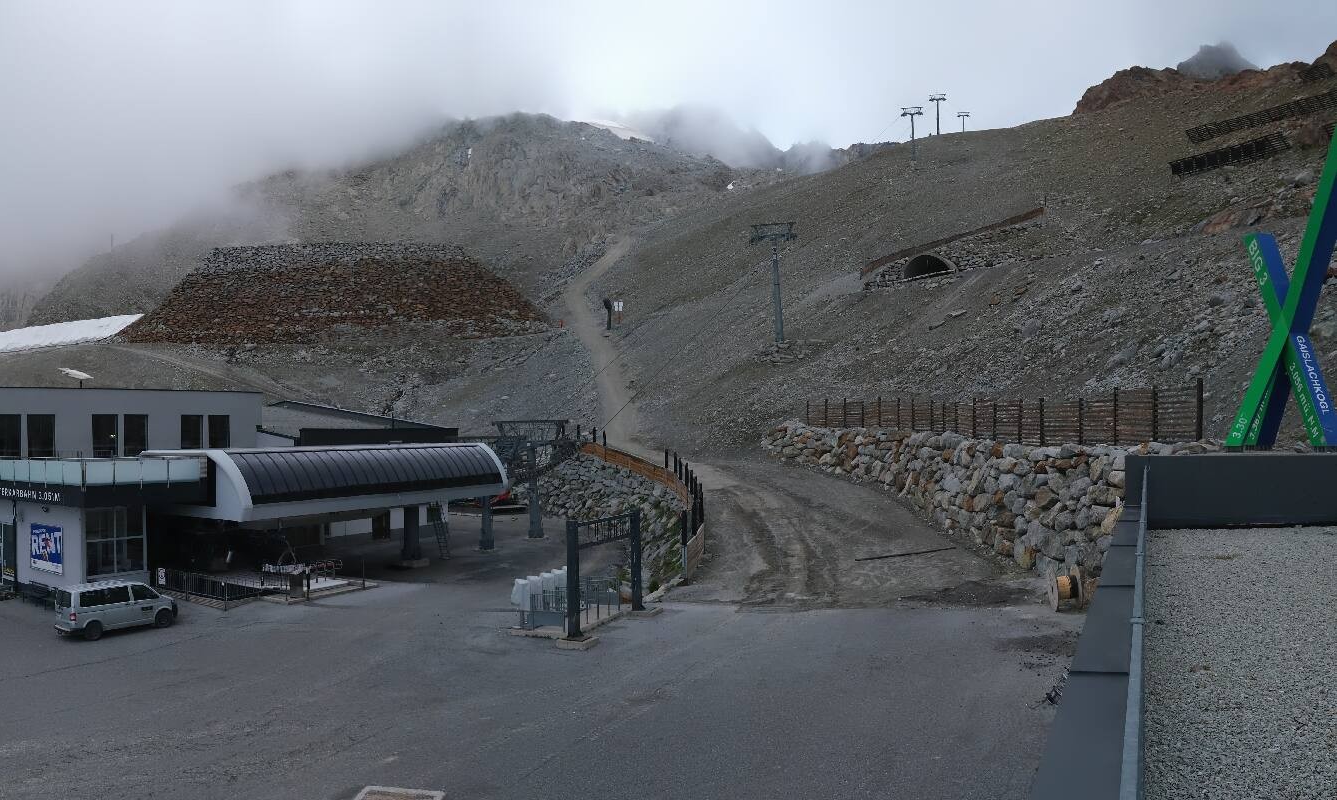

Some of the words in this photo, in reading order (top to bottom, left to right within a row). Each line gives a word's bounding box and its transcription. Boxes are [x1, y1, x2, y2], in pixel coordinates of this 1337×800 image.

[1248, 238, 1263, 273] BIG
[1259, 271, 1268, 286] 3
[1296, 335, 1330, 416] GAISLACHKOGL
[1232, 413, 1248, 439] 3.30
[31, 531, 62, 556] RENT
